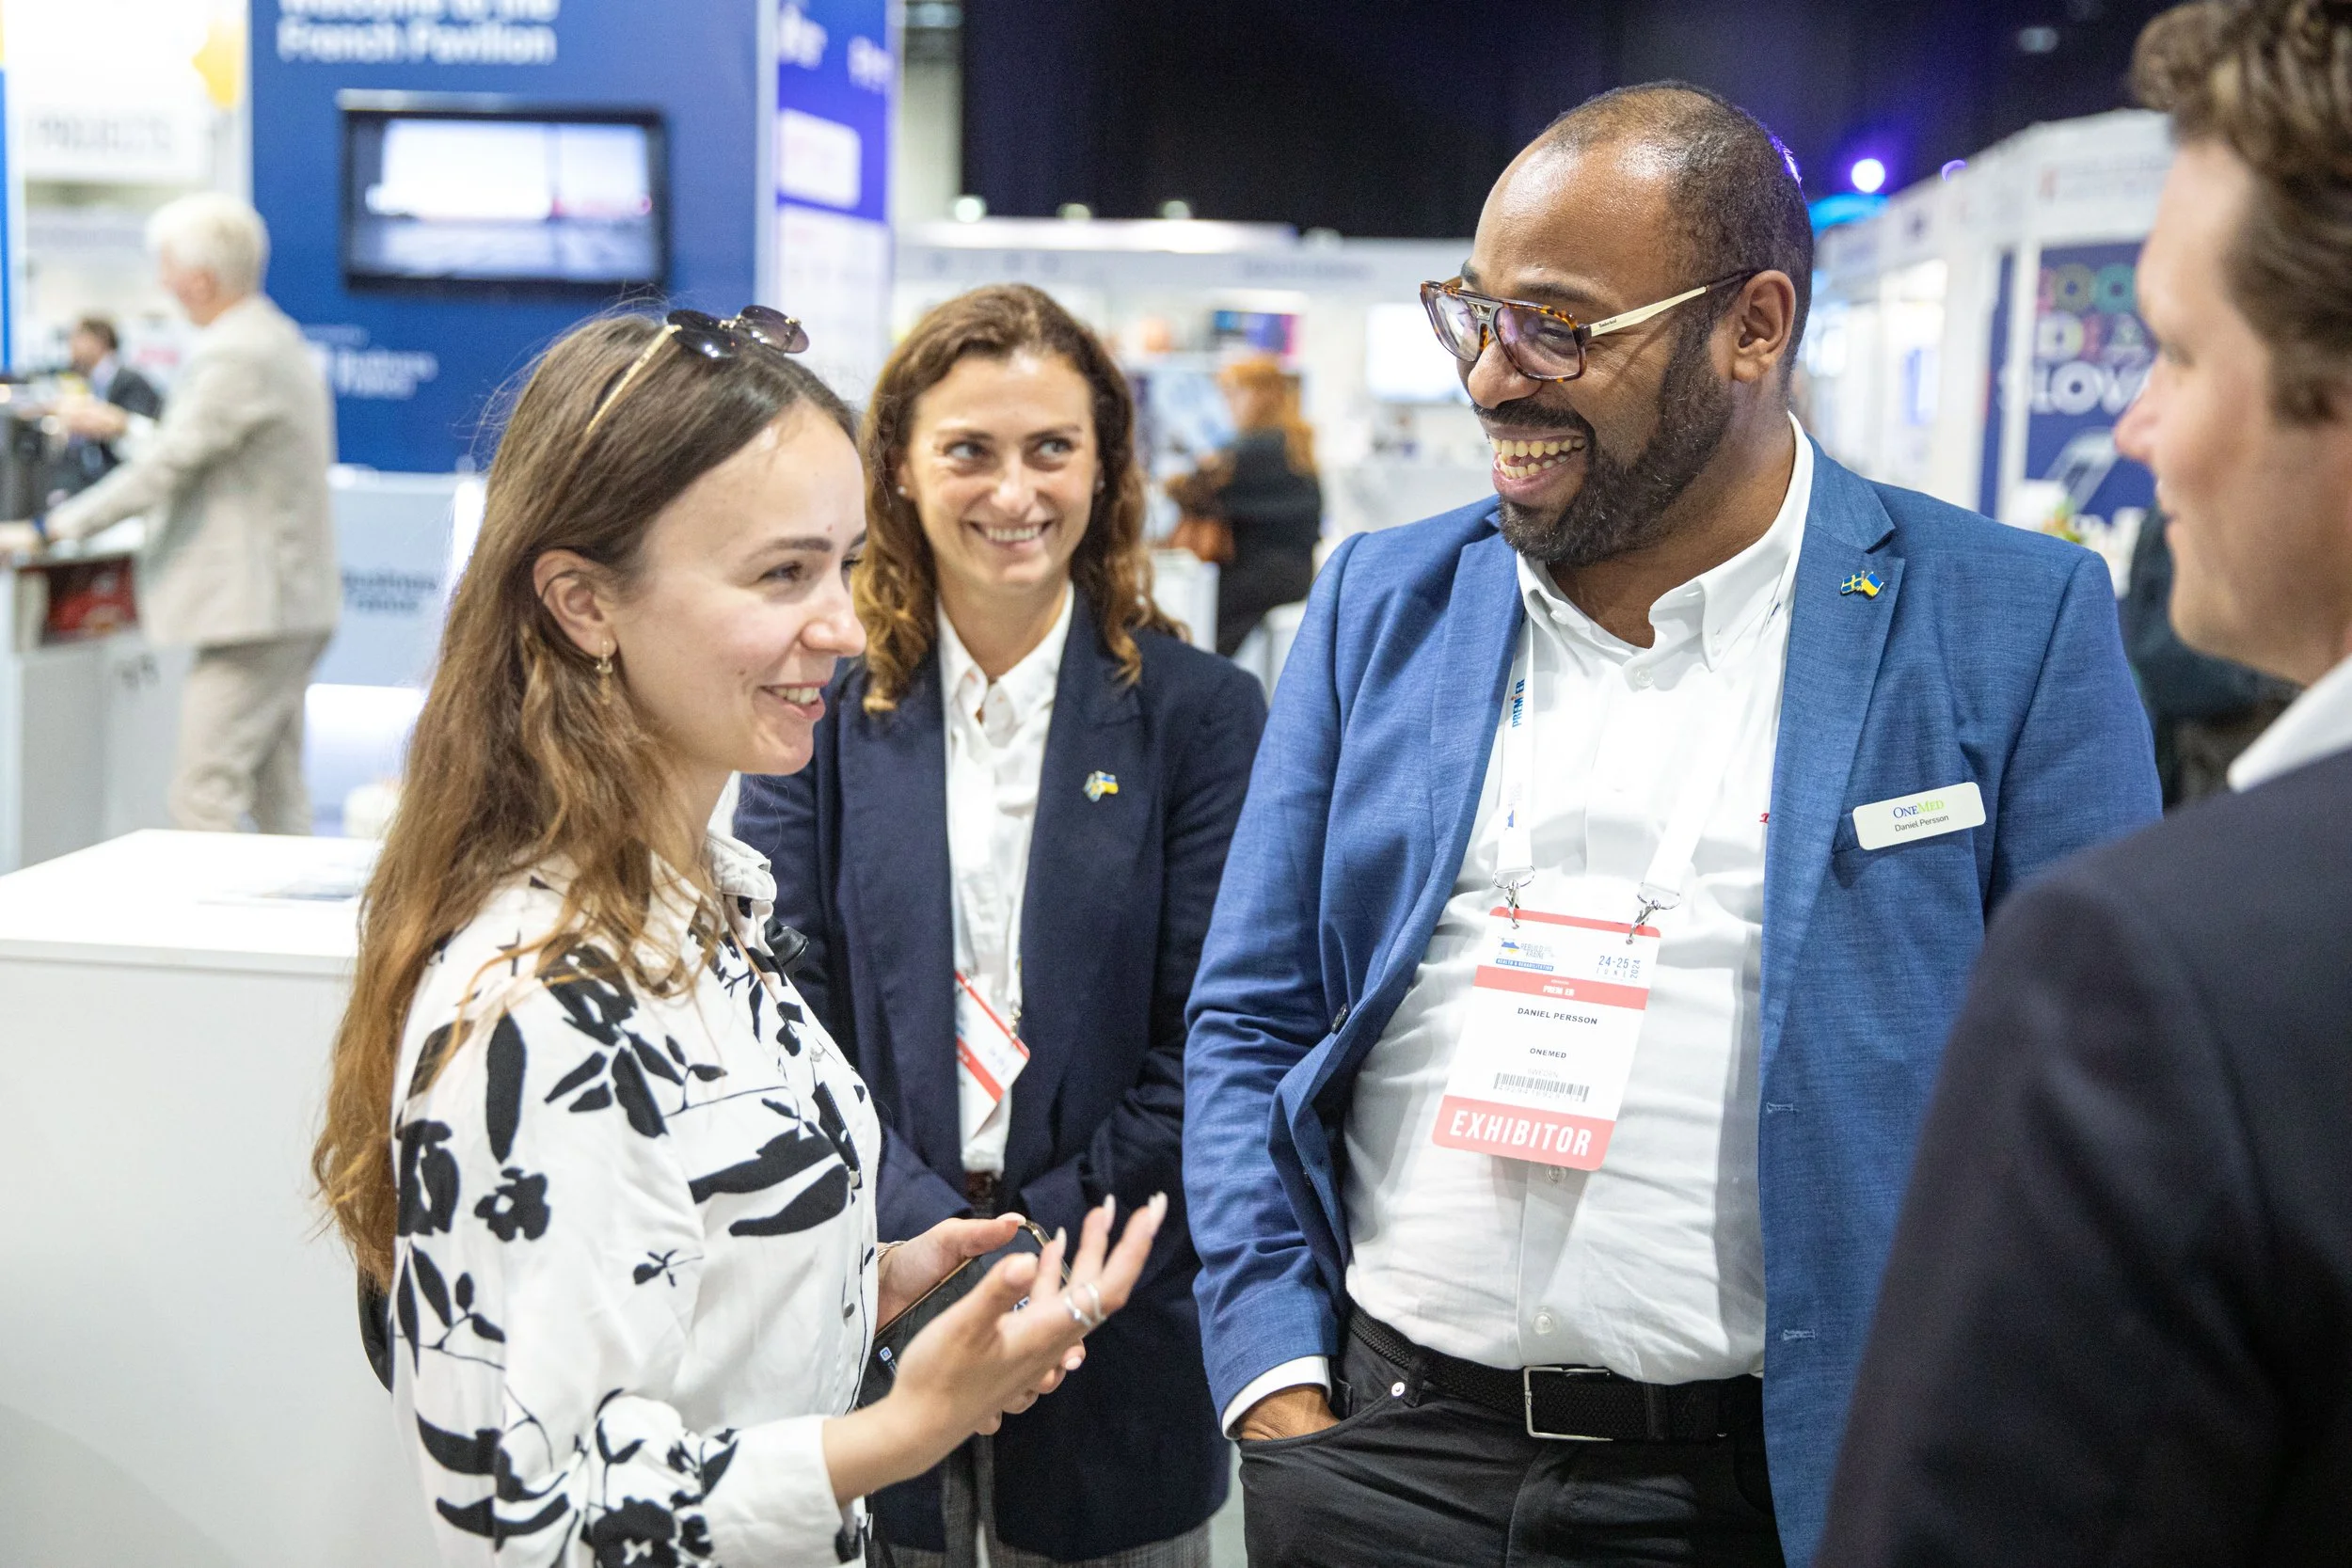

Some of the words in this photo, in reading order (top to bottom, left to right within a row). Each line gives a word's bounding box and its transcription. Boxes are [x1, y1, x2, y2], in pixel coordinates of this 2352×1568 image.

[1895, 820, 1919, 832] Daniel
[1920, 815, 1949, 827] Persson
[1598, 955, 1629, 969] 24-25
[1629, 959, 1641, 979] 2024
[1518, 1007, 1550, 1019] DANIEL
[1553, 1012, 1597, 1024] PERSSON
[1530, 1048, 1566, 1059] ONEMED
[1450, 1110, 1592, 1156] EXHIBITOR
